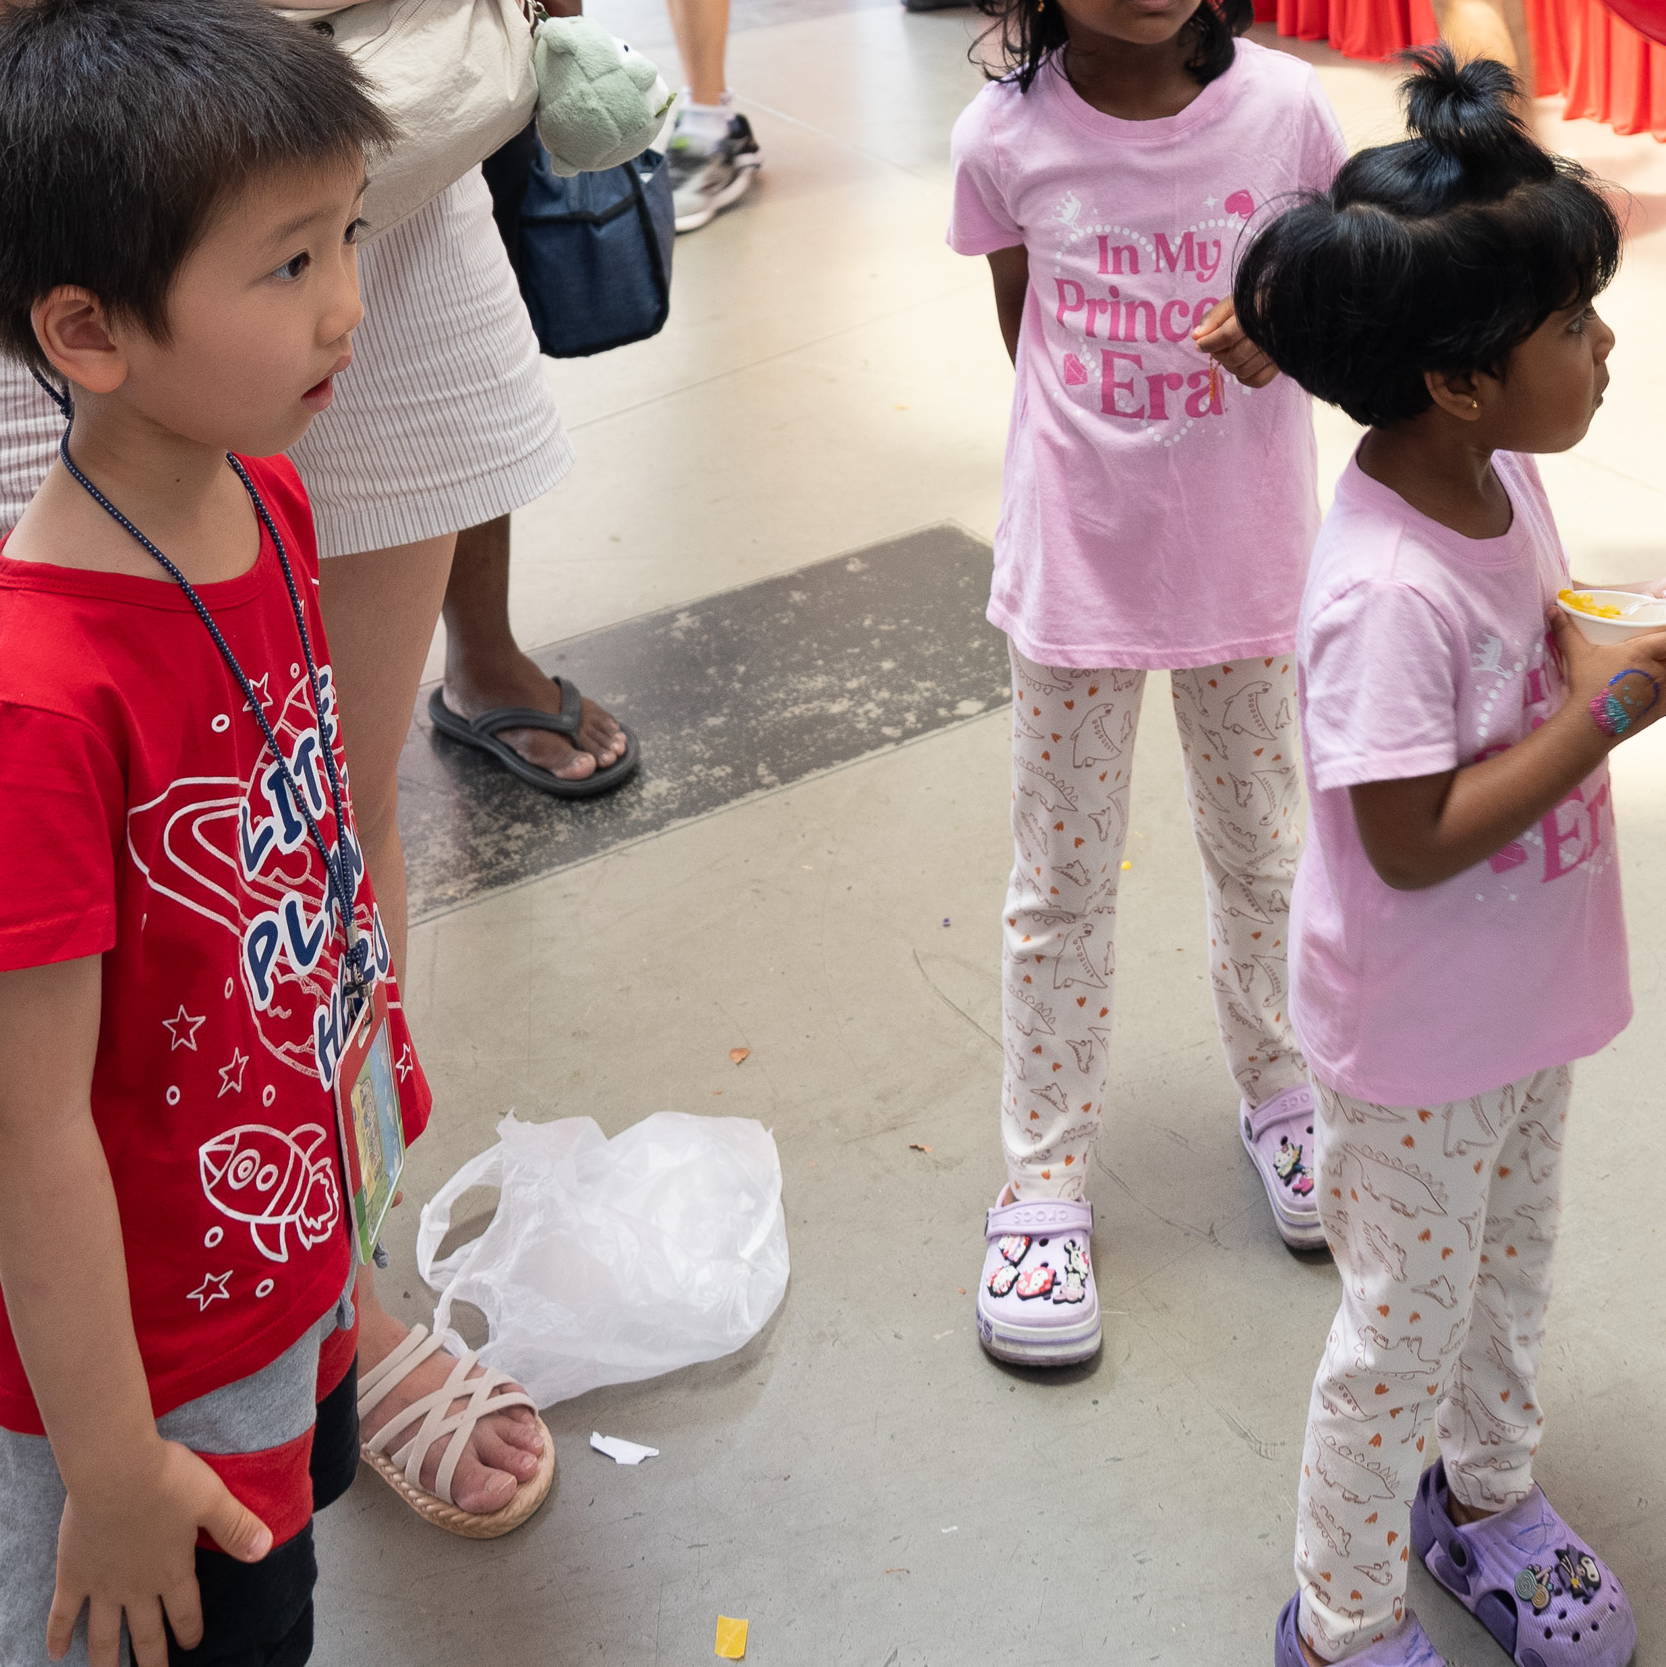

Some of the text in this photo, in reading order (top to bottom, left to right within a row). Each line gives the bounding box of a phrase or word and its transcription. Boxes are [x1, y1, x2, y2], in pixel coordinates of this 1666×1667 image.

[1097, 231, 1222, 283] In My
[1053, 277, 1223, 344] Princ
[1100, 348, 1227, 422] Era
